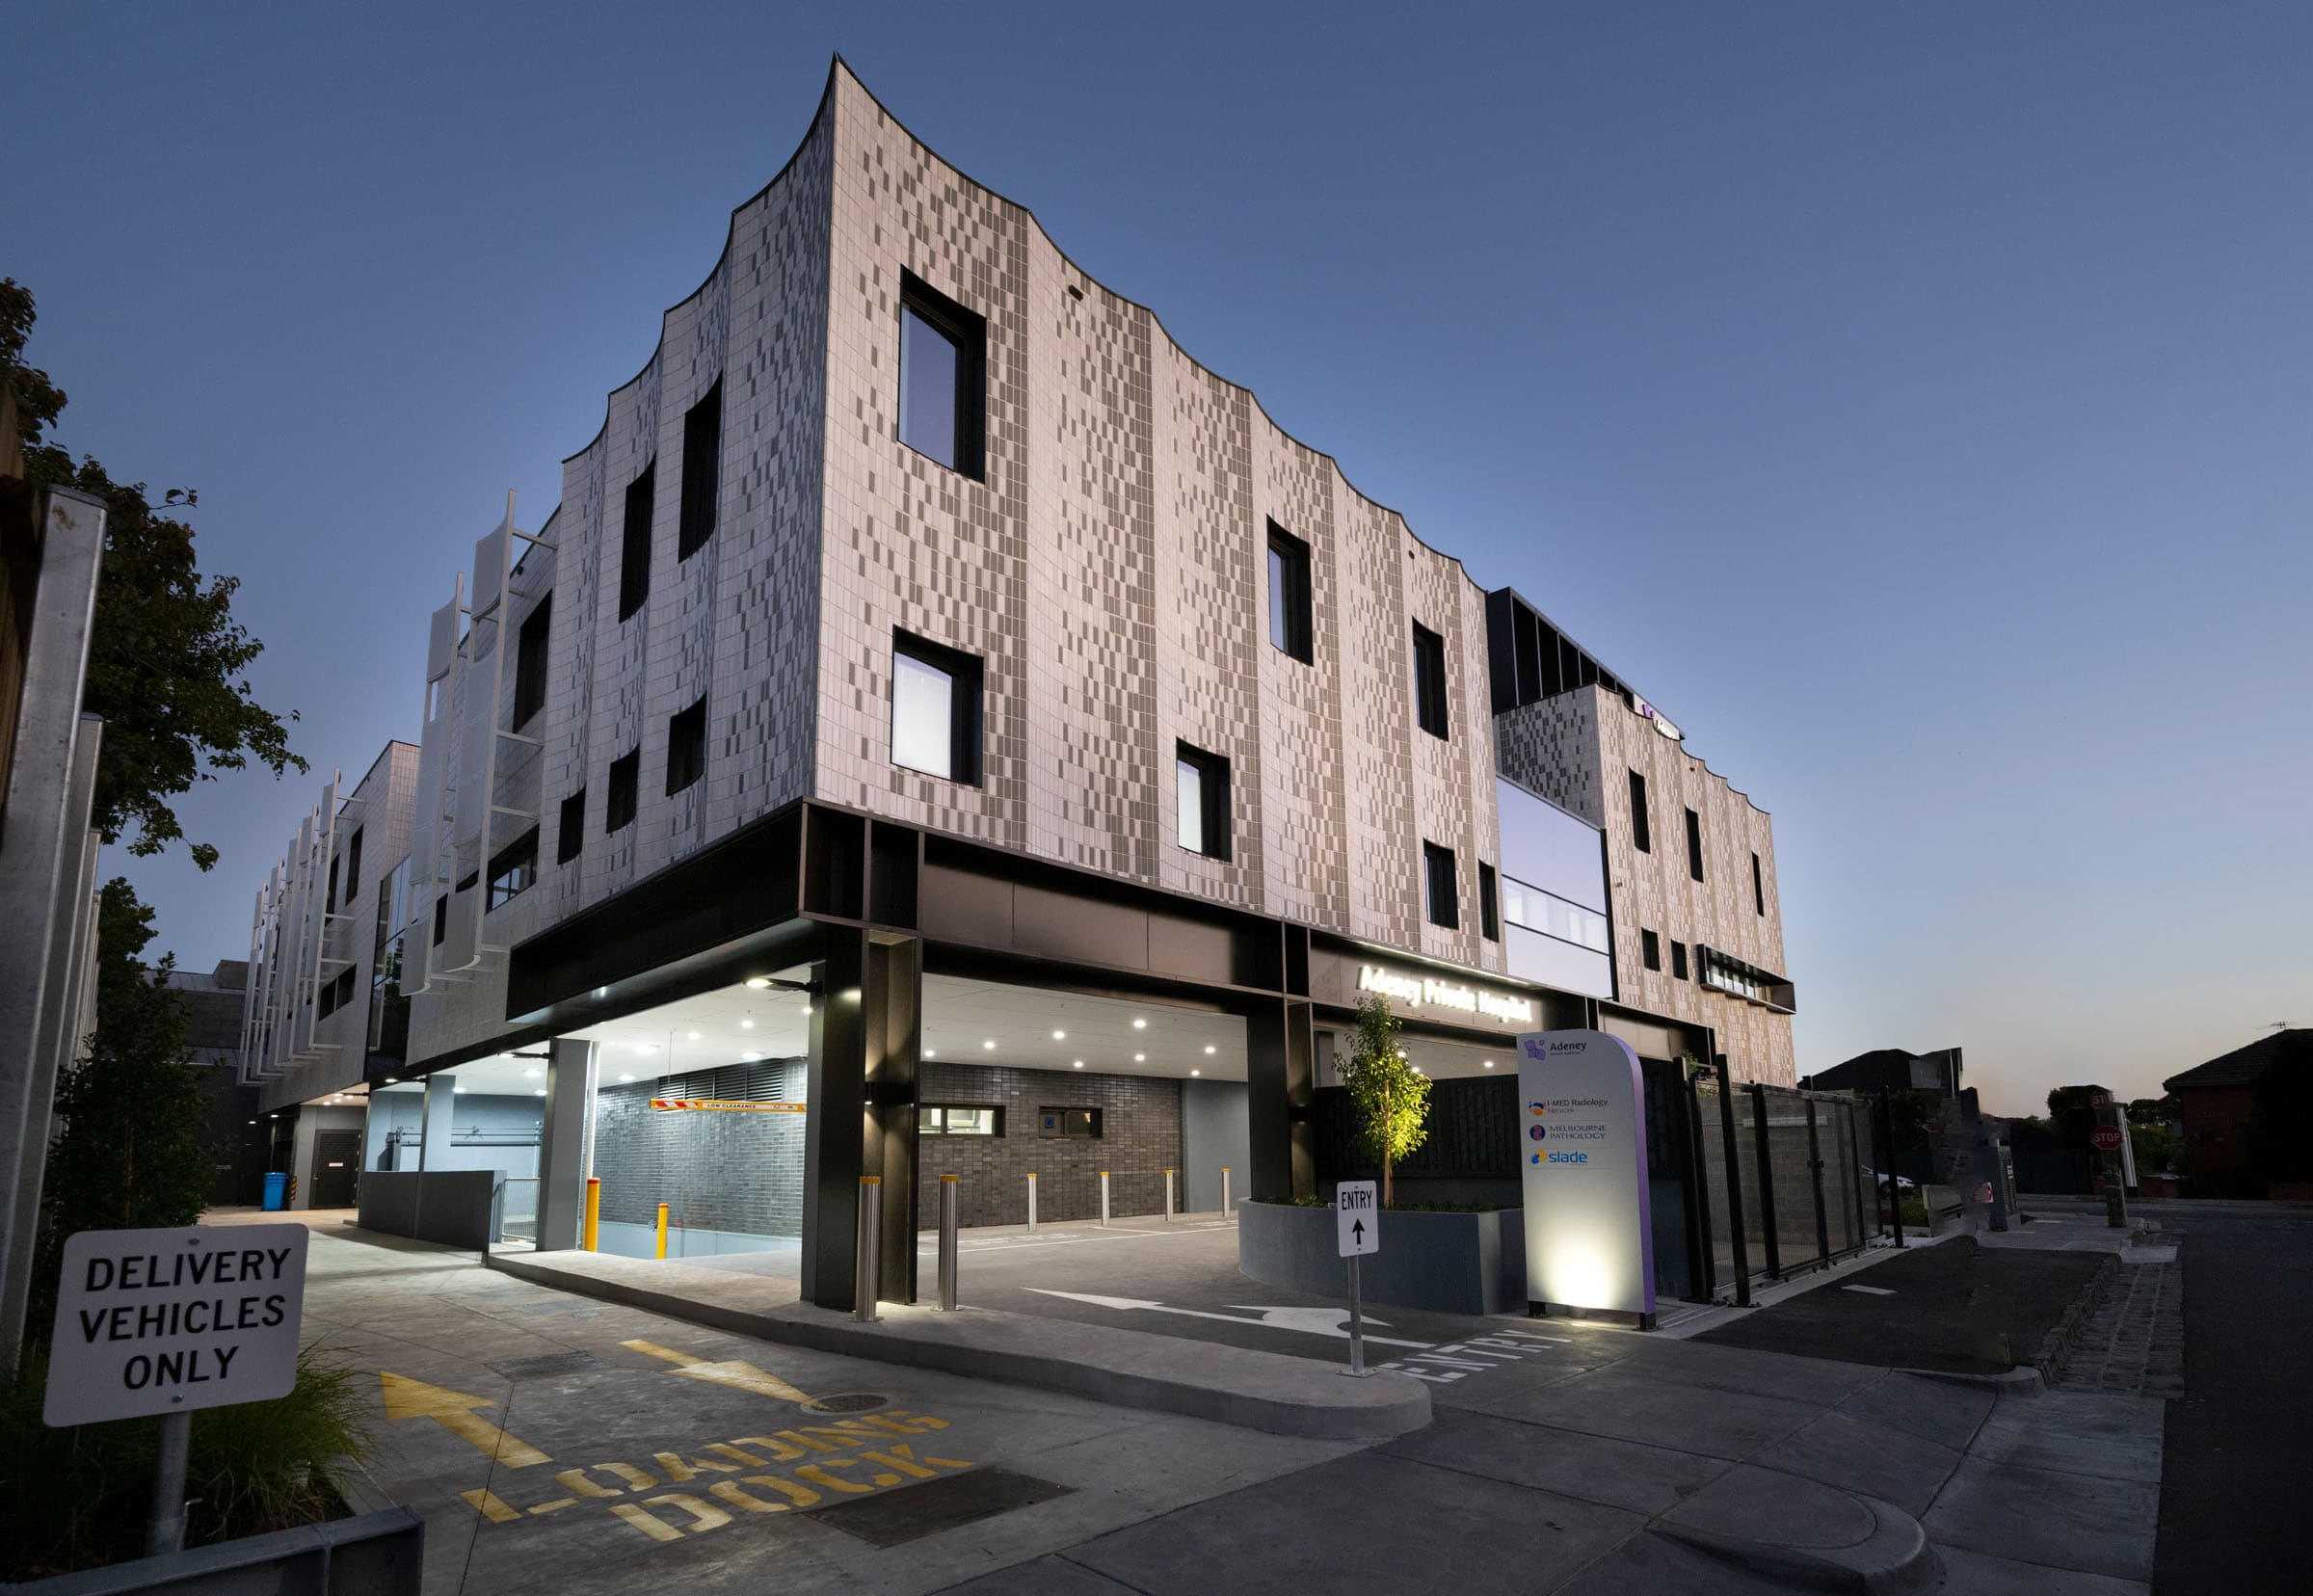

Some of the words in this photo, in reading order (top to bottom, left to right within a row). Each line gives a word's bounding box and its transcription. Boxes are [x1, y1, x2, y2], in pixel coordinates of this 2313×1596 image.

[1550, 1042, 1587, 1051] Adeney
[1571, 1098, 1608, 1107] Radiology
[1549, 1151, 1588, 1163] slade
[2093, 1132, 2121, 1142] STOP
[1341, 1189, 1373, 1210] ENTRY
[85, 1248, 292, 1292] DELIVERY
[79, 1294, 285, 1343] VEHICLES
[123, 1345, 239, 1390] ONLY
[1376, 1329, 1573, 1383] ENTRY
[460, 1410, 953, 1524] LOADING
[607, 1443, 978, 1543] DOCK
